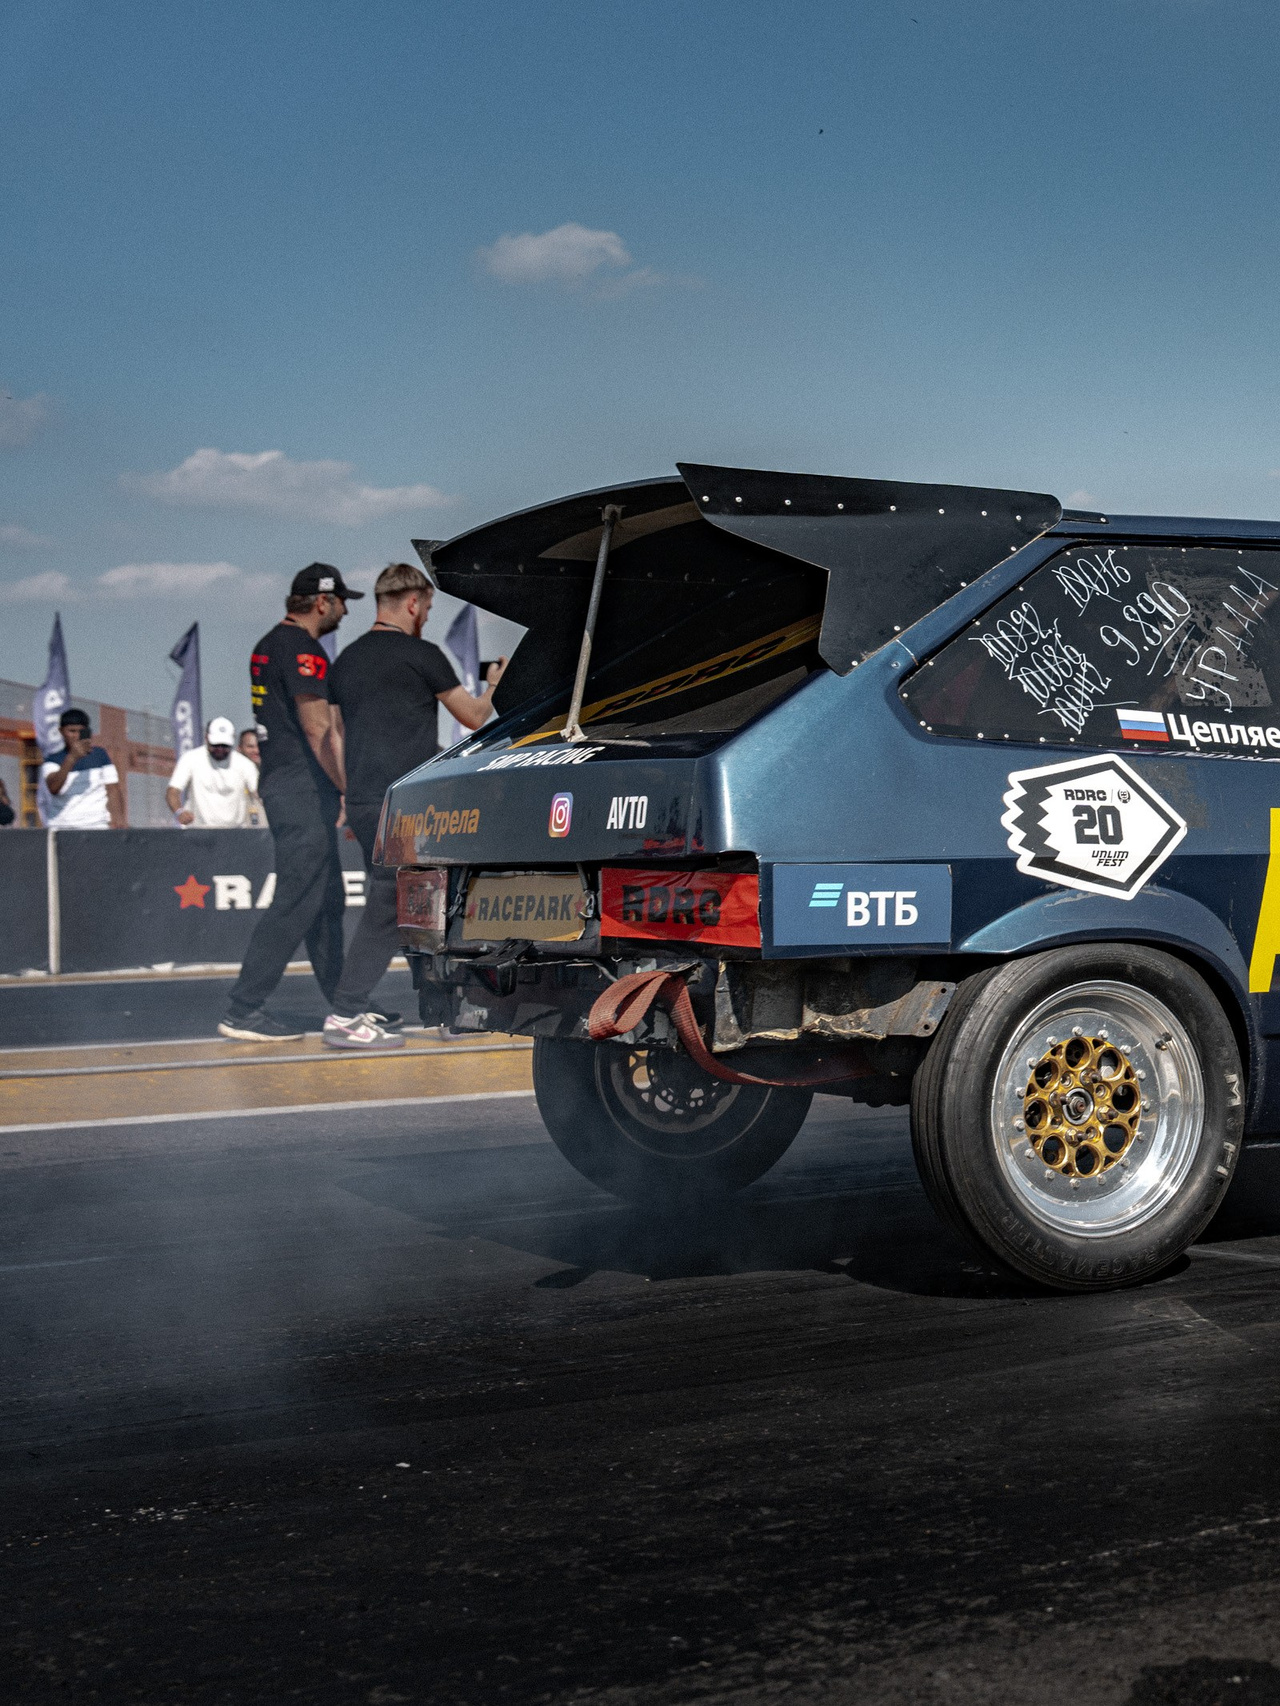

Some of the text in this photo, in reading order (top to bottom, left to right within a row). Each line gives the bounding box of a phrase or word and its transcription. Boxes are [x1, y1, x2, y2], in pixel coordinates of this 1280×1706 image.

[1100, 581, 1191, 666] 9.890
[513, 746, 606, 768] RACING
[606, 795, 648, 830] AVTO
[1063, 788, 1108, 802] RDRC
[390, 804, 481, 843] АтмоСтрела
[1072, 804, 1124, 846] 20
[1096, 858, 1126, 868] FEST
[477, 894, 575, 922] RACEPARK
[622, 885, 722, 927] RDRC
[847, 891, 919, 927] ВТБ
